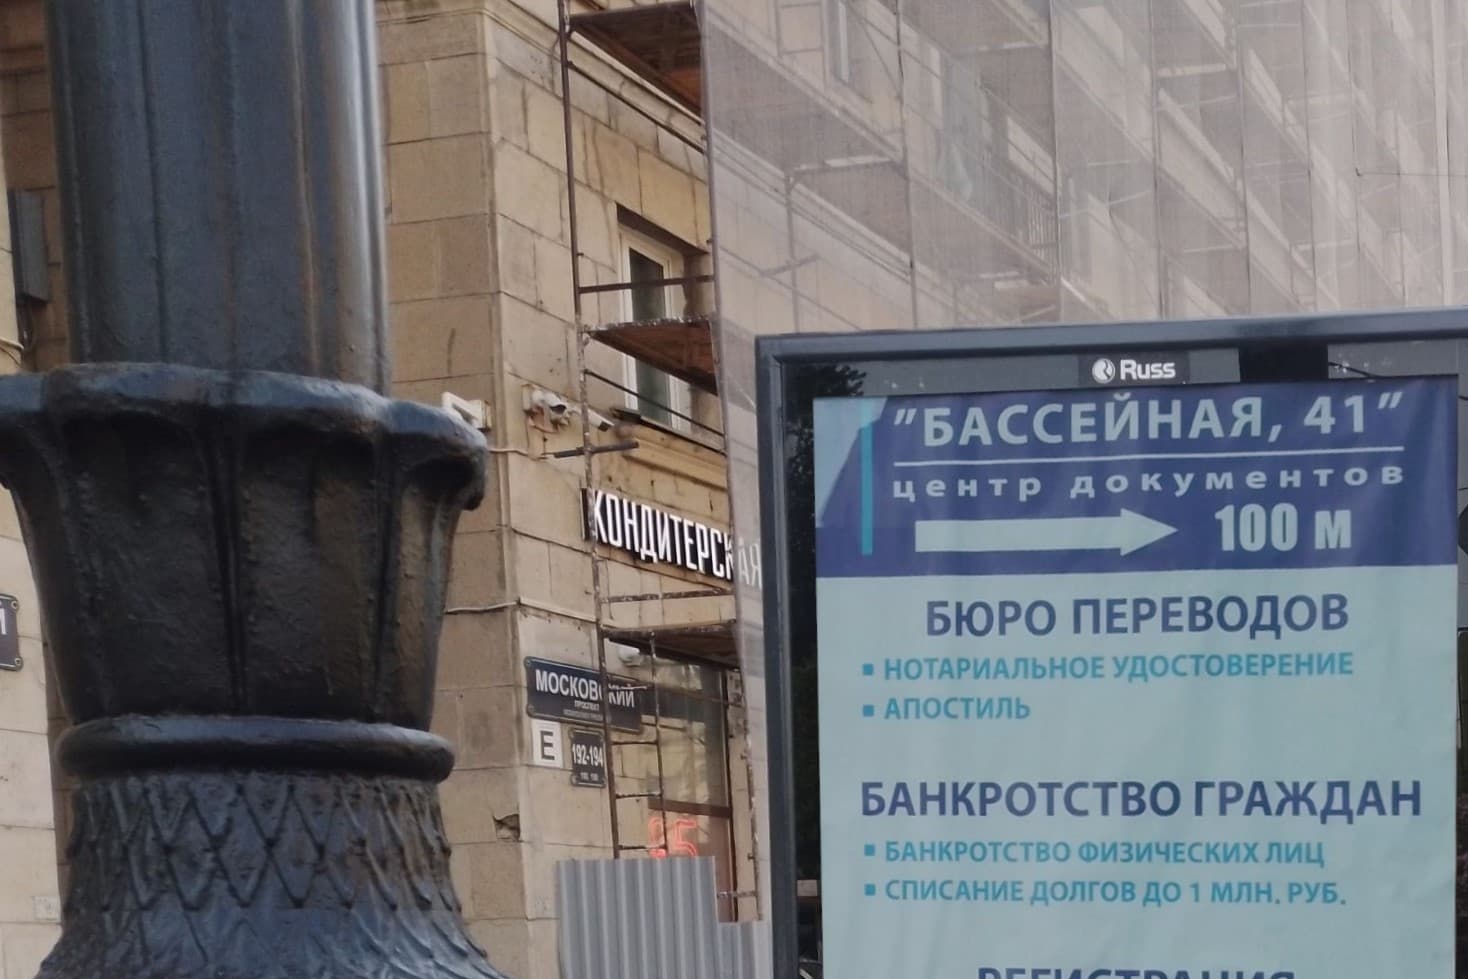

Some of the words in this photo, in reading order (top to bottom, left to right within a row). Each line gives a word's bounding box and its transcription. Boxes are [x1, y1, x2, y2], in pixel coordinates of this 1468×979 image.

[1120, 360, 1176, 380] Russ
[893, 478, 1041, 502] центр
[1069, 464, 1404, 500] документов
[1215, 503, 1297, 551] 100
[928, 600, 1056, 637] БЮРО
[1074, 594, 1348, 640] ПЕРЕВОДОВ
[885, 656, 1104, 680] НОТАРИАЛЬНОЕ
[1112, 652, 1352, 682] УДОСТОВЕРЕНИЕ
[884, 697, 1030, 720] АПОСТИЛЬ
[862, 781, 1181, 816] БАНКРОТСТВО
[1195, 780, 1420, 824] ГРАЖДАН
[886, 841, 1071, 862] БАНКРОТСТВО
[1079, 842, 1259, 863] ФИЗИЧЕСКИХ
[1265, 842, 1324, 868] ЛИЦ
[886, 880, 1023, 901] СПИСАНИЕ
[1030, 881, 1136, 906] ДОЛГОВ
[1142, 881, 1181, 907] ДО
[1190, 882, 1199, 902] 1
[1211, 882, 1280, 904] МЛН.
[1288, 882, 1346, 905] РУБ.
